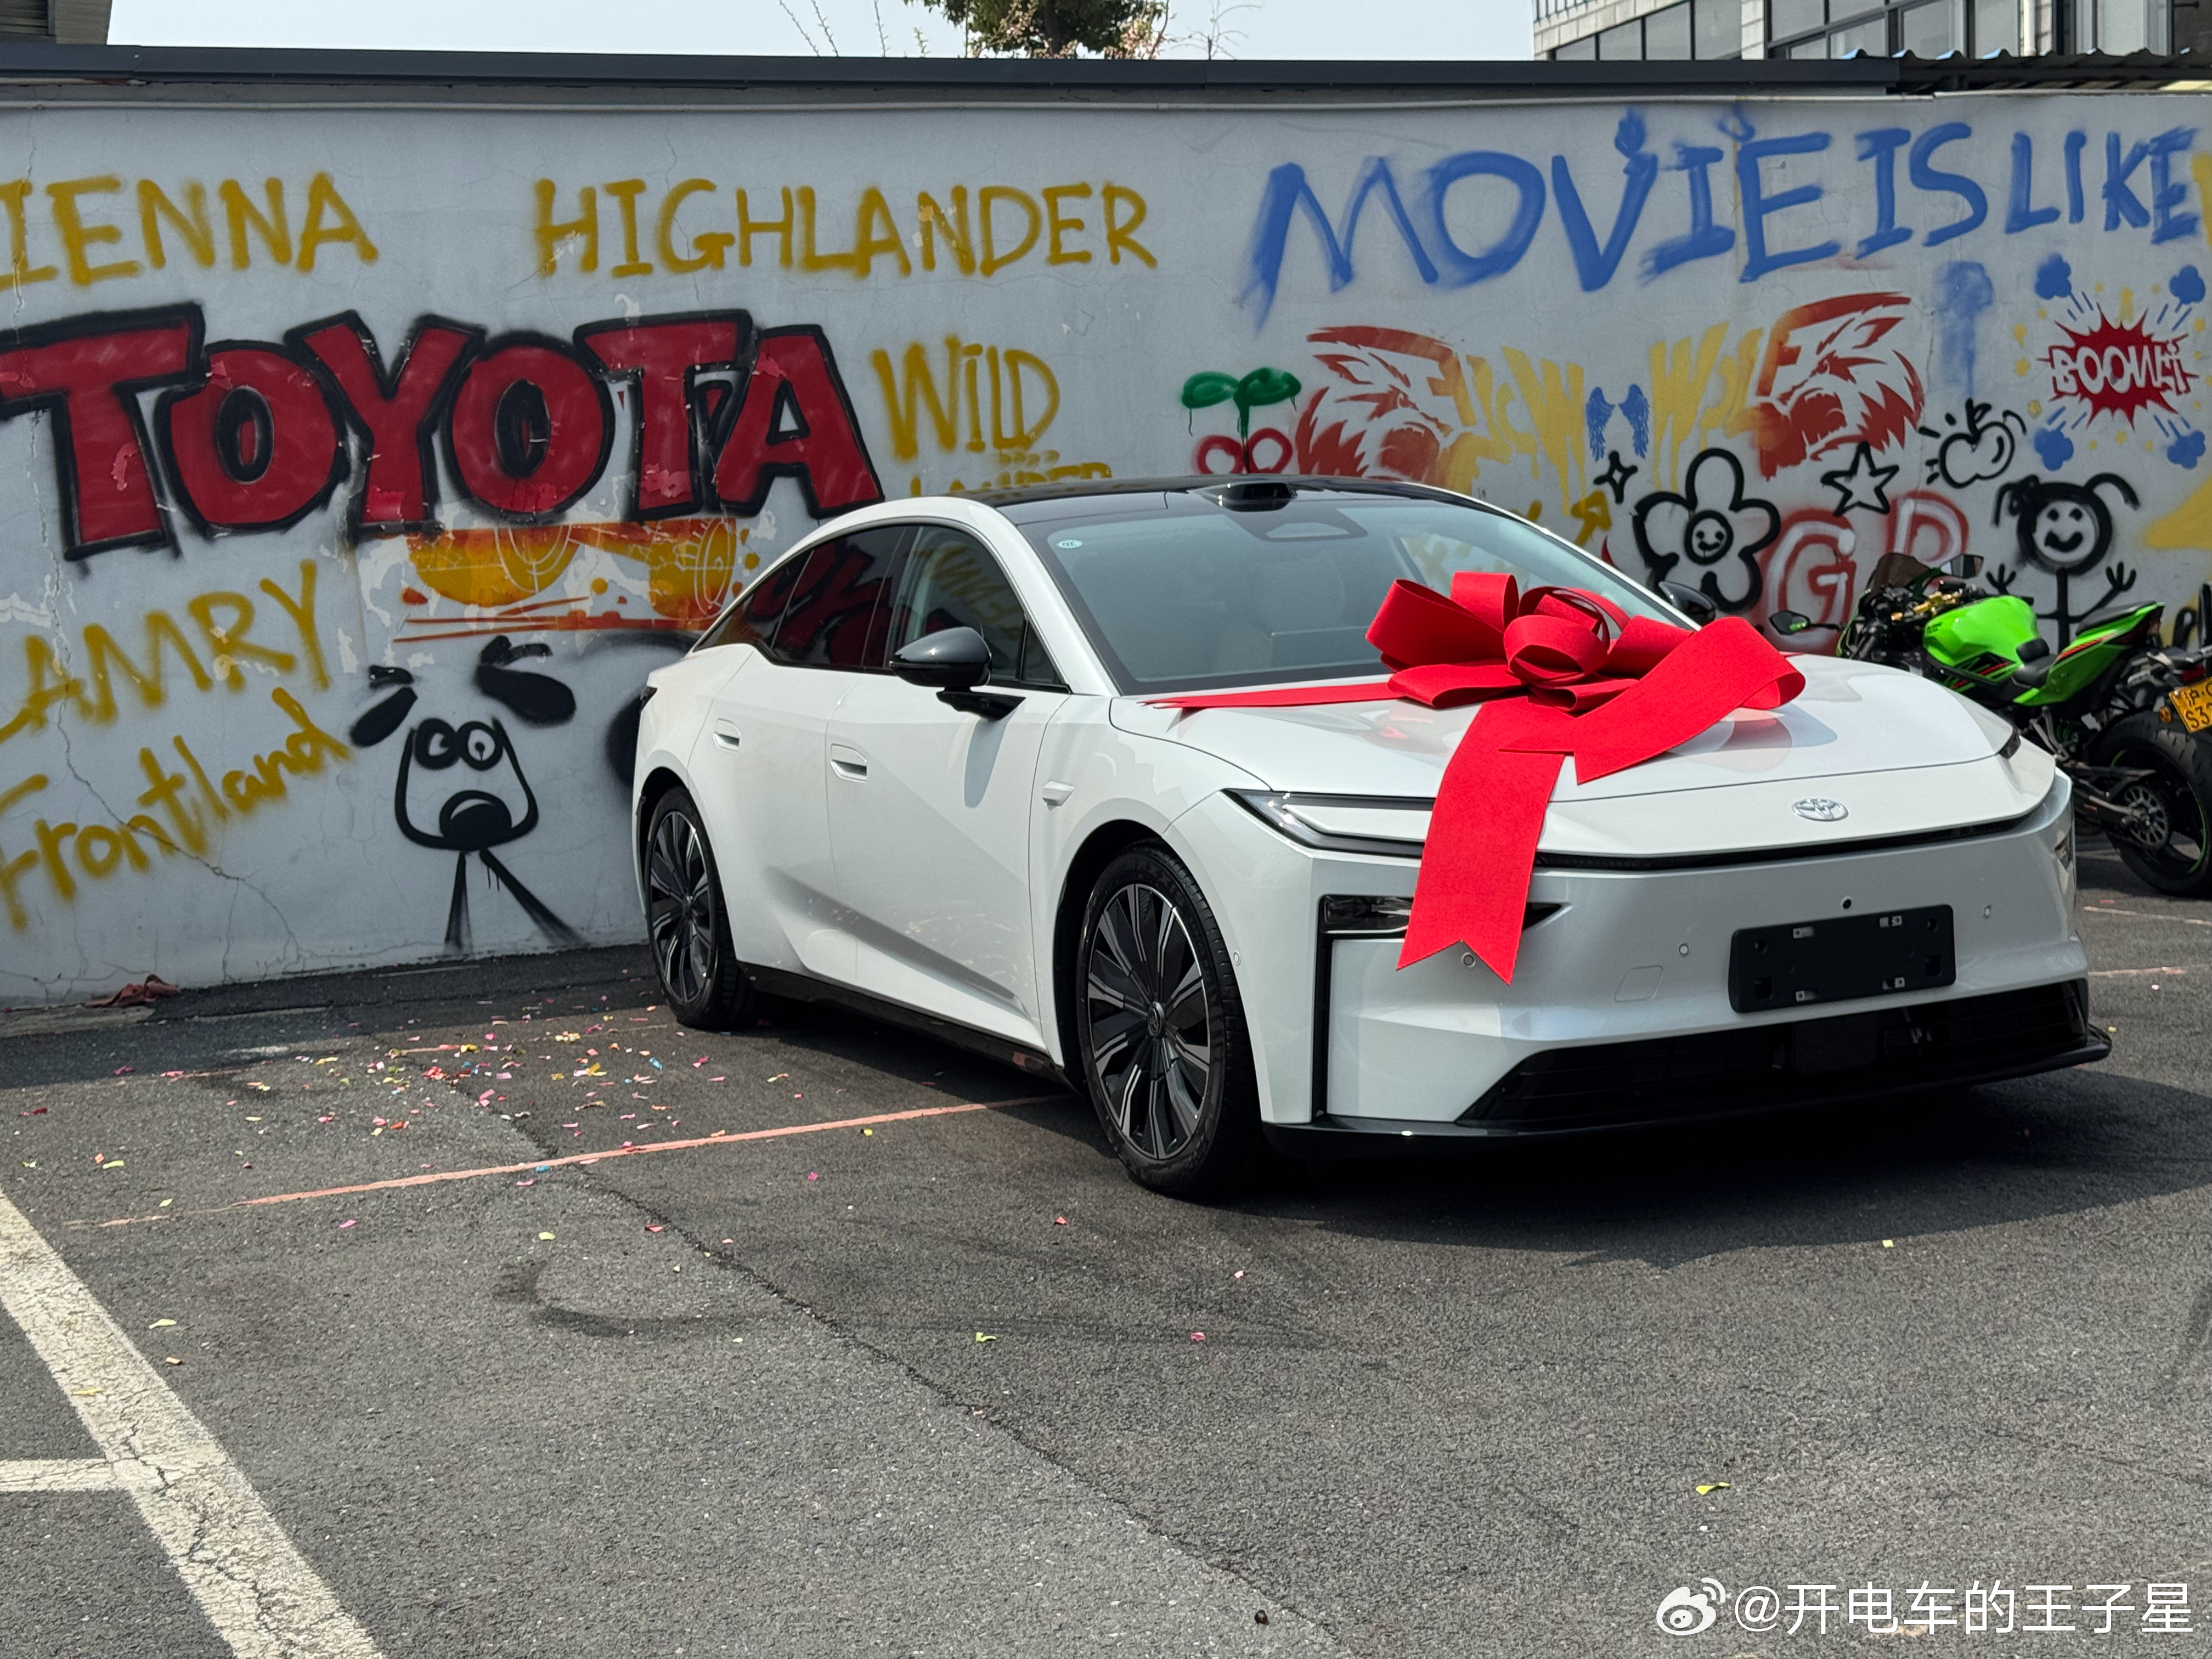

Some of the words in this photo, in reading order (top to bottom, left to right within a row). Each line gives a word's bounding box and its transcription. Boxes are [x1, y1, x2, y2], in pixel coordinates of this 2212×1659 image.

[532, 177, 1160, 279] HIGHLANDER
[2004, 127, 2199, 244] LIKE
[0, 300, 885, 565] TOYOTA
[0, 560, 332, 744] AMRY
